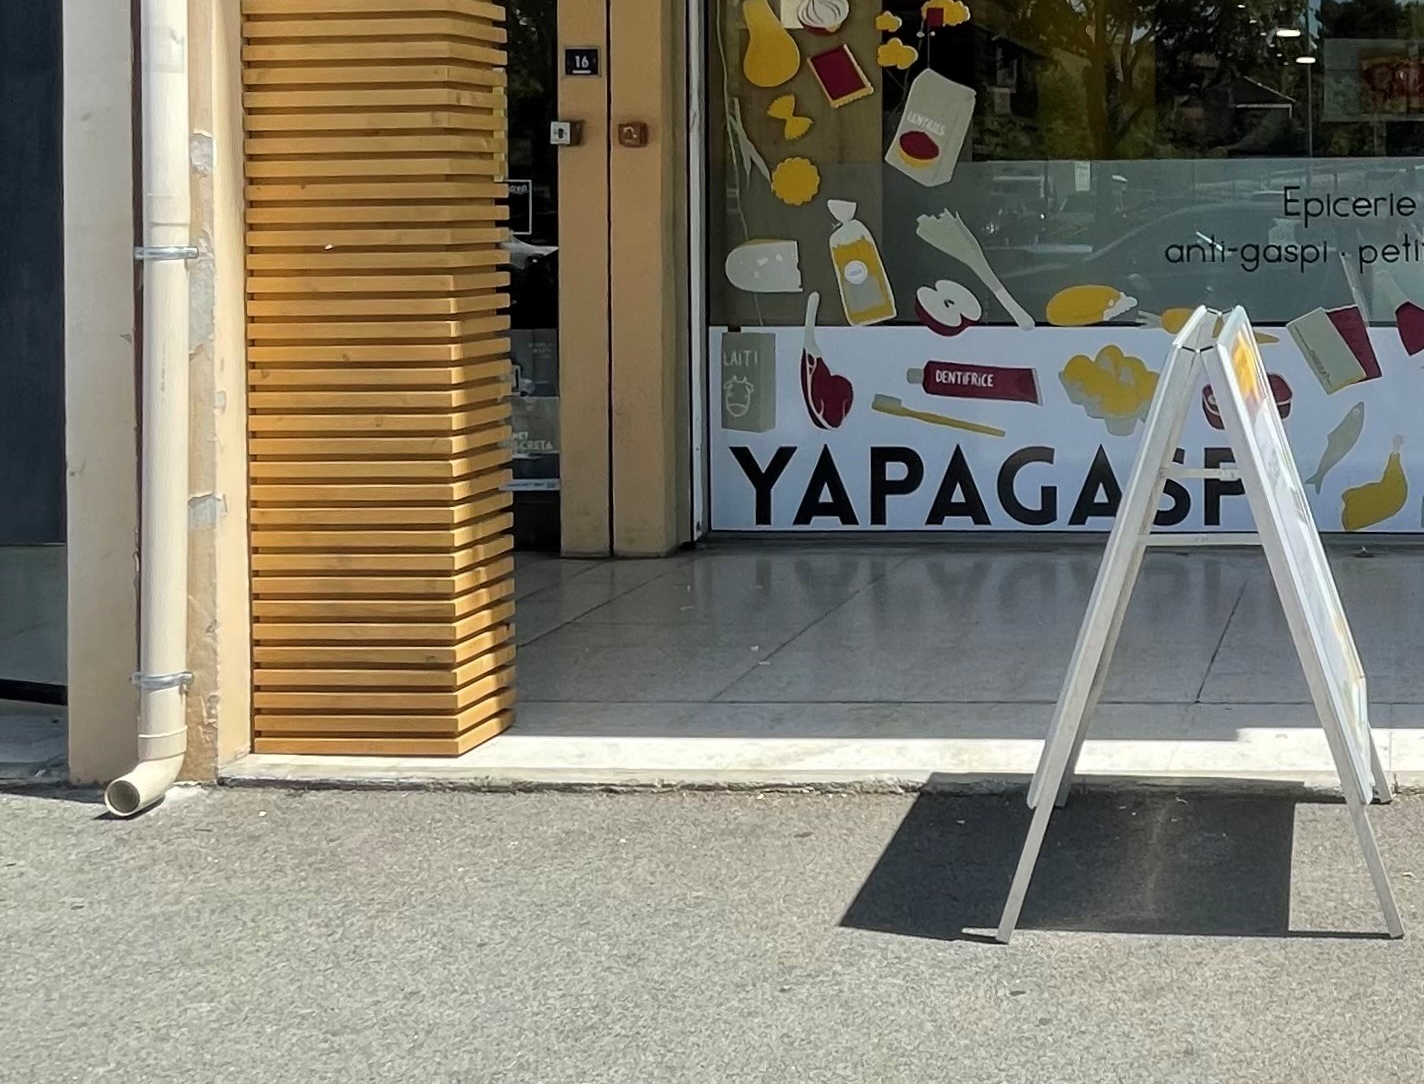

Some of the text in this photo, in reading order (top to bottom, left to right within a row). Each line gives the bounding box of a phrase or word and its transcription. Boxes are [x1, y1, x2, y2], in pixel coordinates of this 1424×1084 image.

[574, 55, 590, 68] 16
[1283, 186, 1417, 228] Epicerie
[1164, 234, 1328, 272] anti-gaspi
[935, 369, 994, 388] DENTIFRICE
[729, 443, 1246, 527] YAPAGASP
